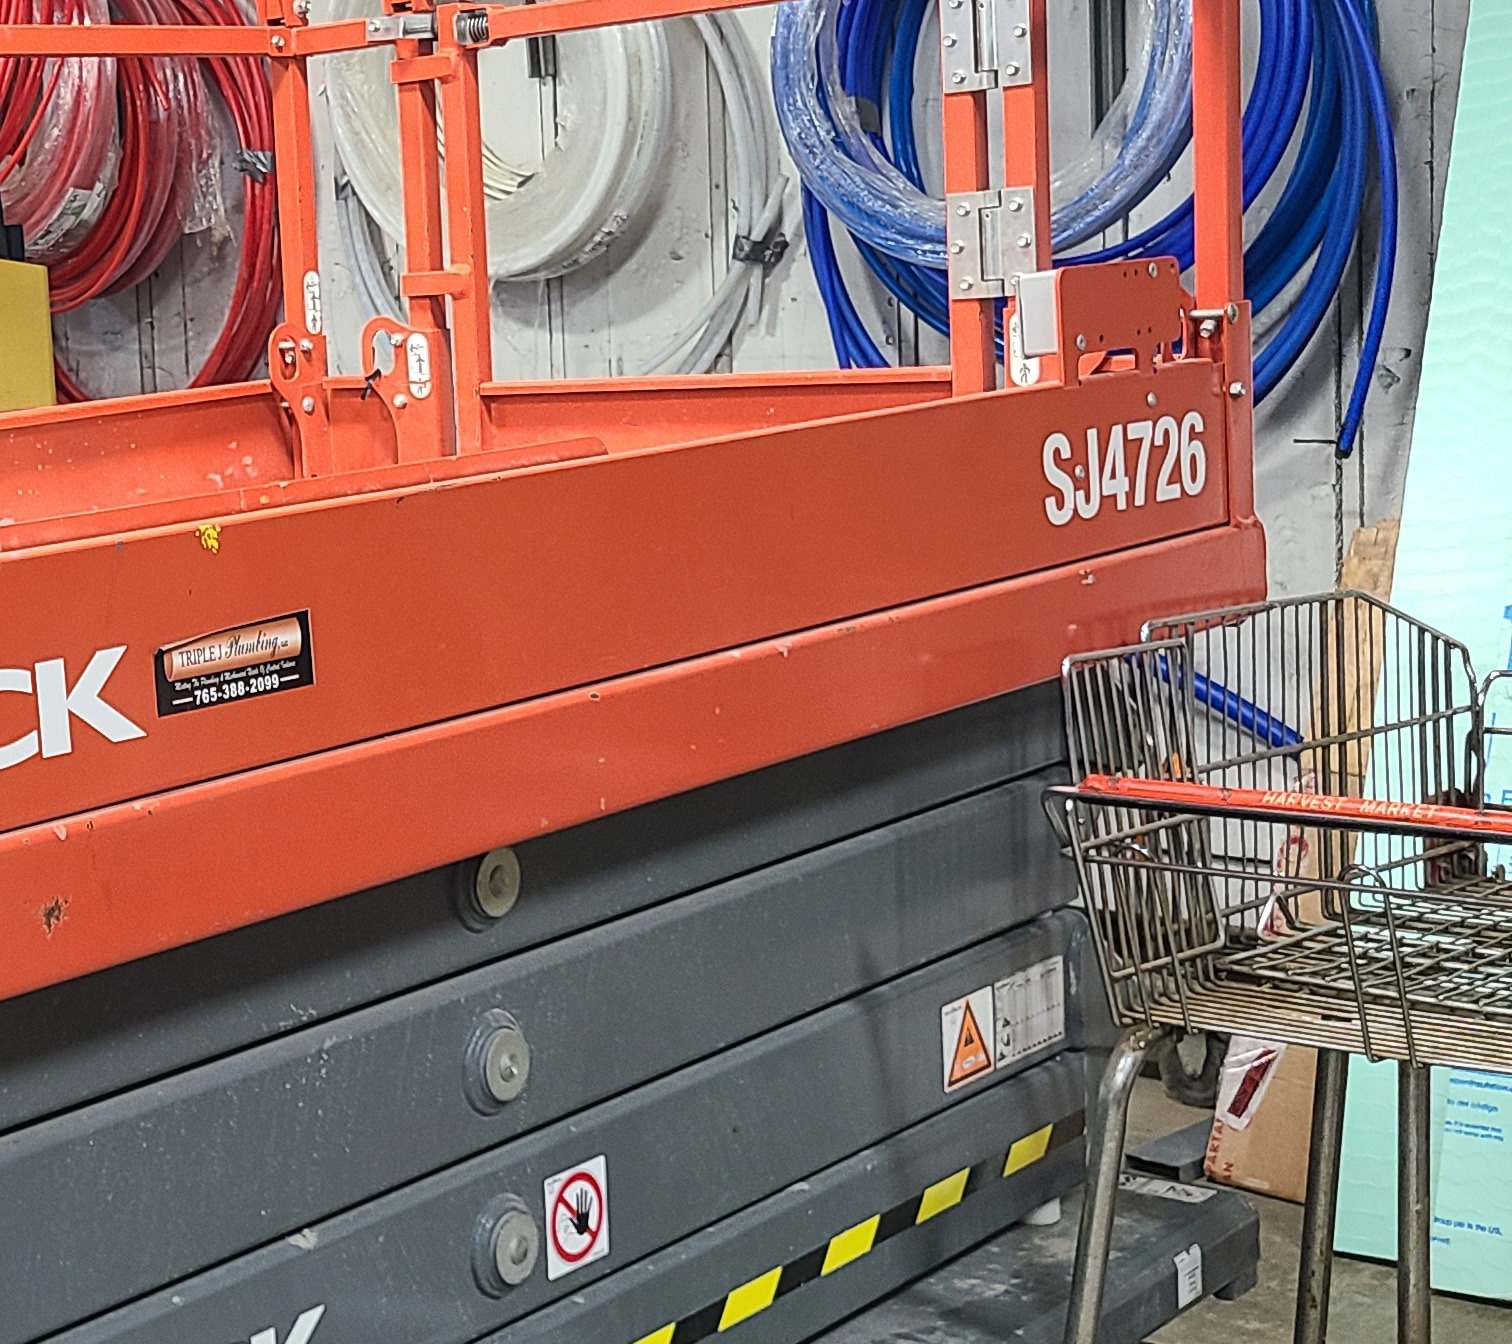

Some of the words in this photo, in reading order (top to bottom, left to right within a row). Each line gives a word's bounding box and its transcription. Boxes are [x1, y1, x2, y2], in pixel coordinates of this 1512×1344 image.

[1043, 411, 1207, 526] SJ4726
[178, 645, 216, 667] TRIPLE
[1262, 791, 1348, 811] HARVEST
[1359, 800, 1439, 819] MARKET
